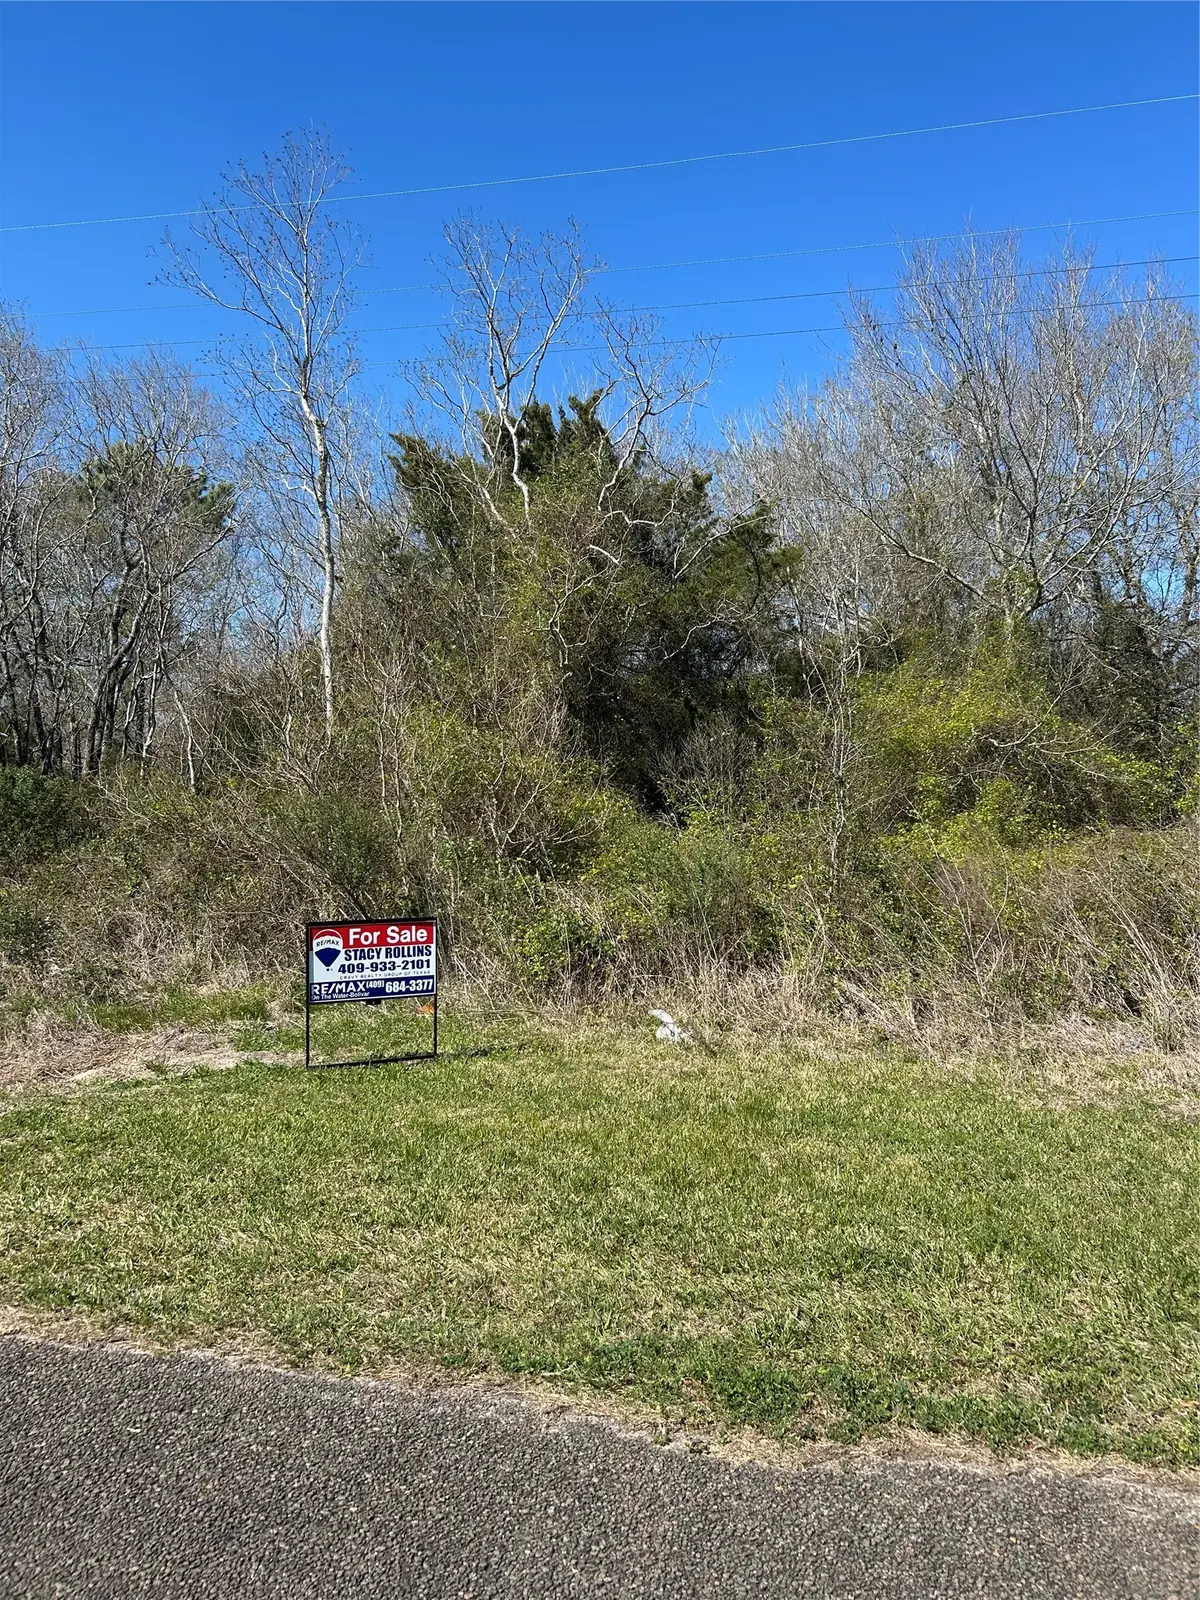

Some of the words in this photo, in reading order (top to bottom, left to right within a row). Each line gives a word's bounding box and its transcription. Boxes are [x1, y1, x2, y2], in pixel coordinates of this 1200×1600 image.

[348, 928, 380, 946] For
[386, 925, 428, 944] Sale
[316, 939, 340, 948] RE/MAX
[344, 947, 384, 961] STACY
[385, 945, 432, 959] ROLLINS
[338, 959, 430, 974] 409-933-2101
[311, 981, 366, 995] RE/MAX
[366, 980, 385, 989] (409)
[385, 979, 433, 993] 684-3377
[332, 991, 370, 999] Water-Bolivar
